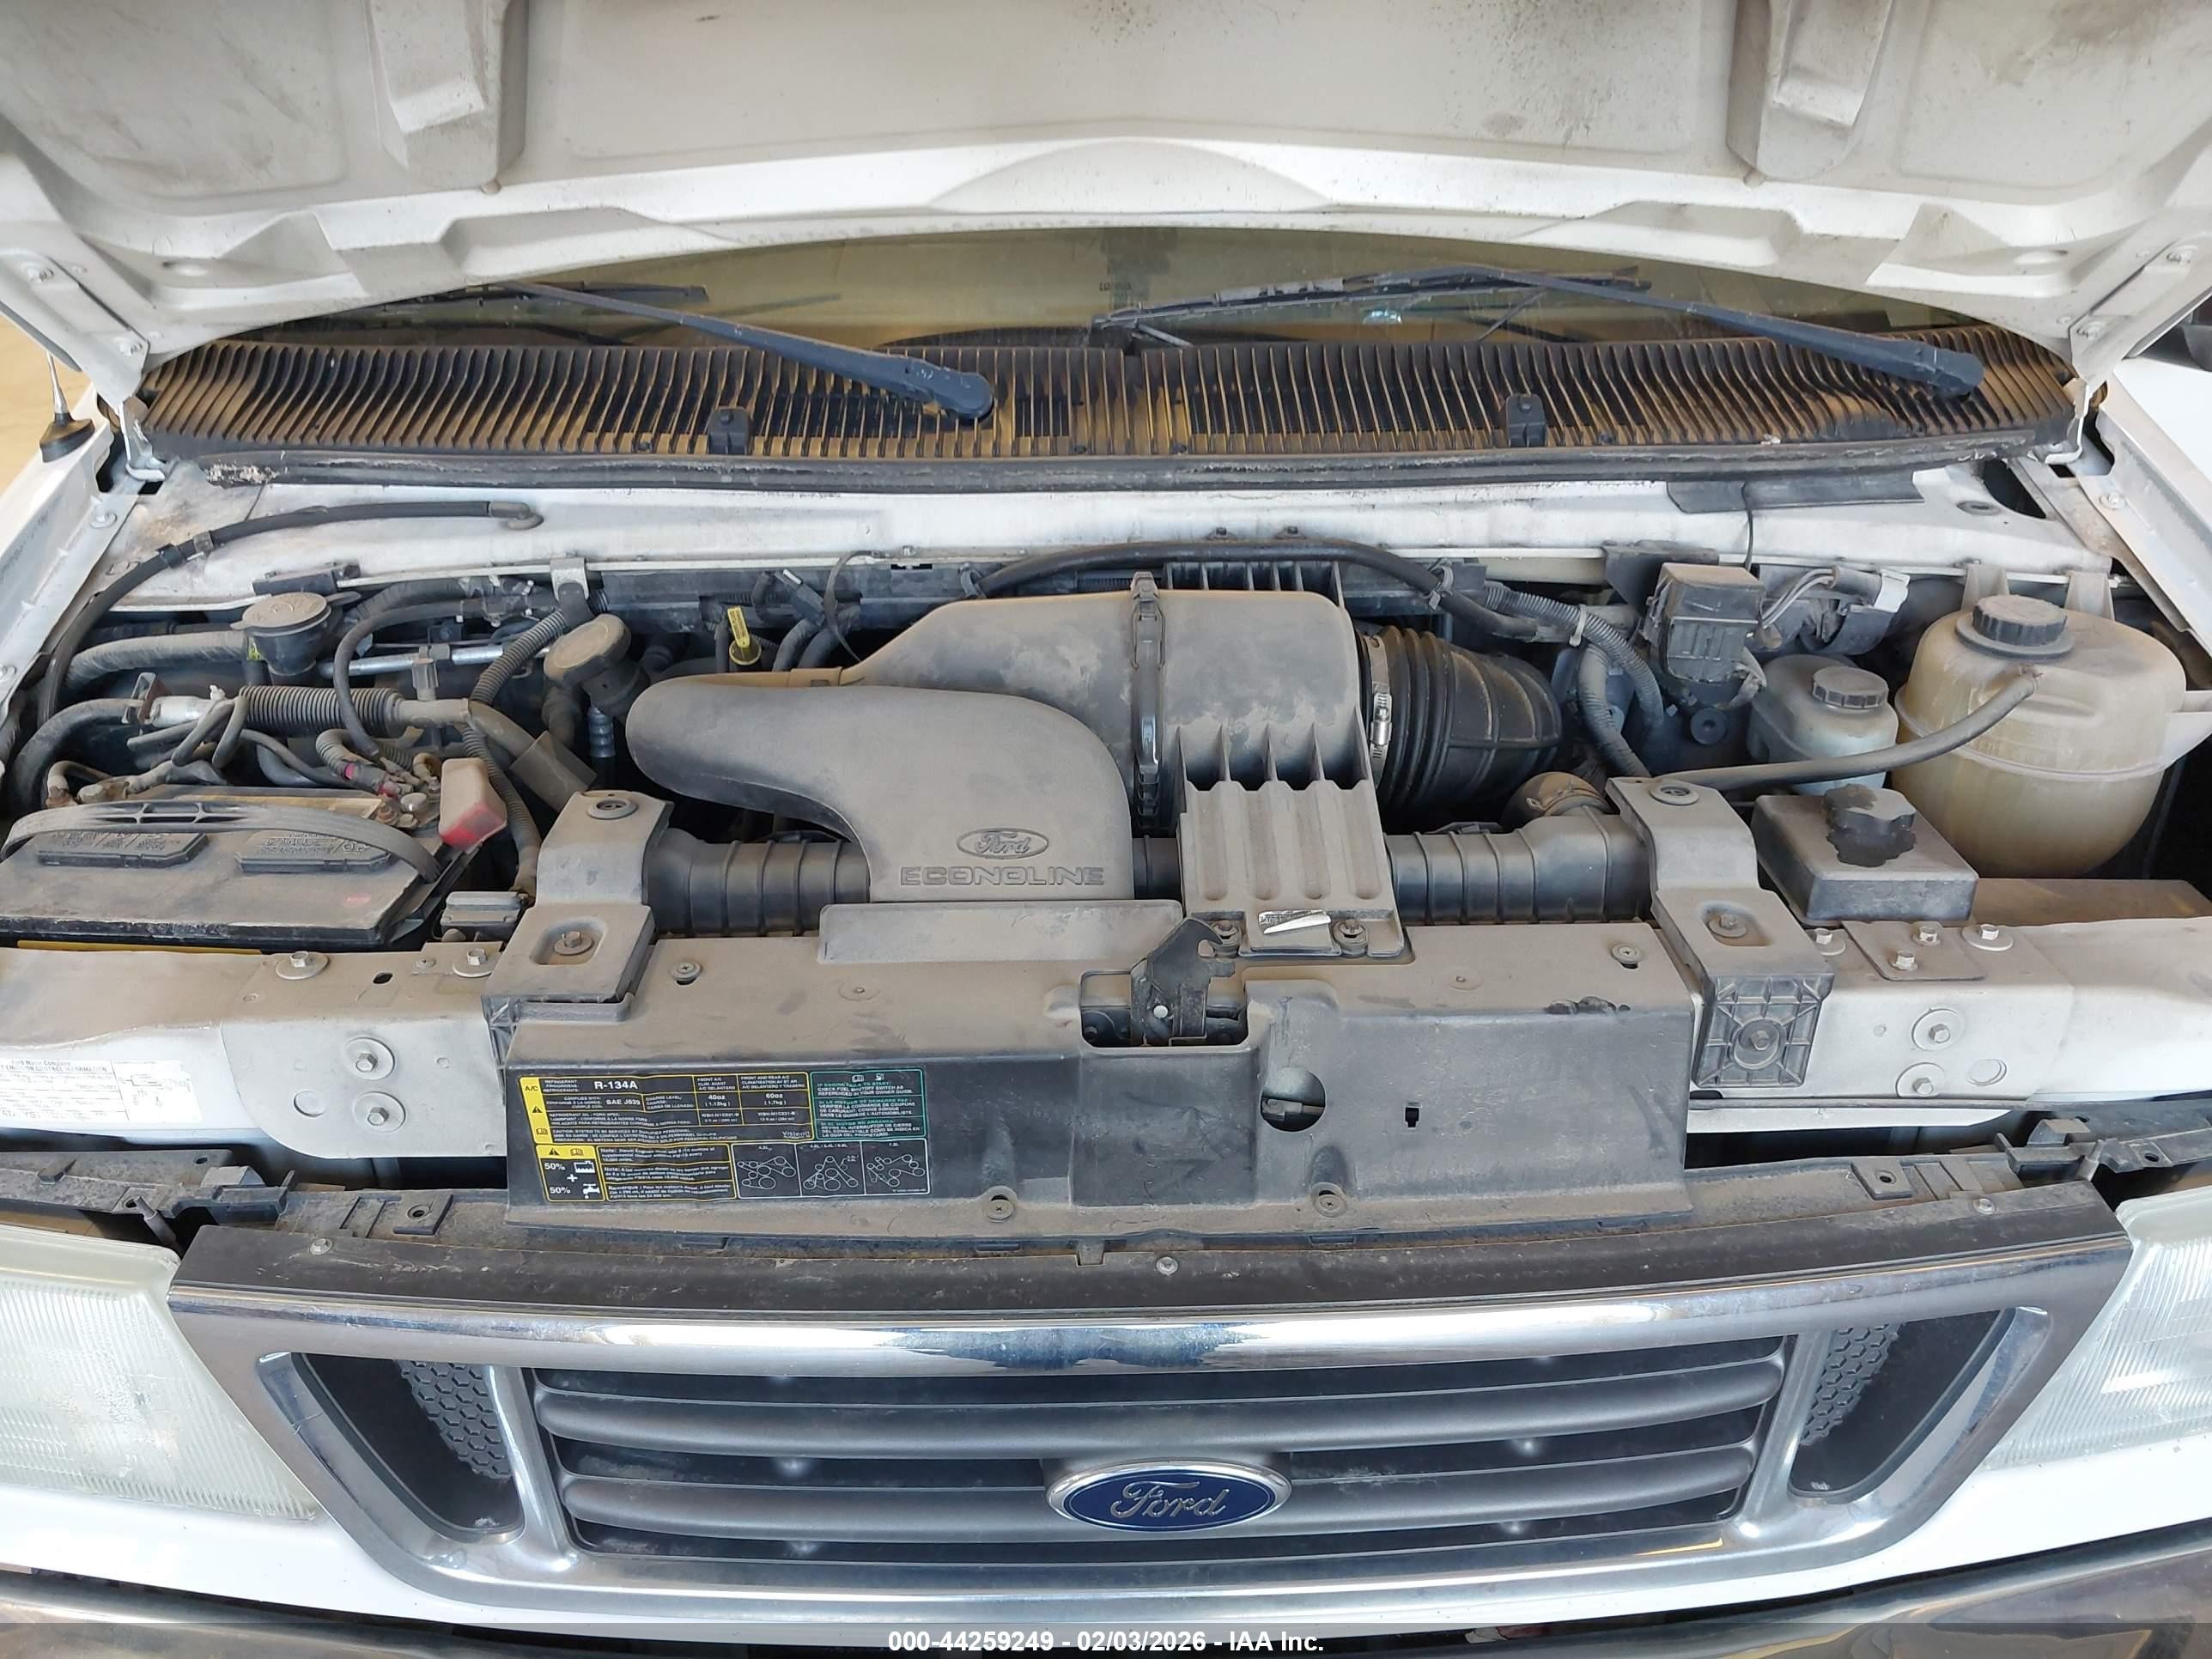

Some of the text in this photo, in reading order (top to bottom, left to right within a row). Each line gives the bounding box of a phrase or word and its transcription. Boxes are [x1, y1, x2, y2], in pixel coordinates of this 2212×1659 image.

[975, 830, 1030, 854] Ford
[901, 866, 1104, 886] ECONOLINE
[594, 1080, 638, 1090] R-134A
[1109, 1480, 1231, 1518] Ford
